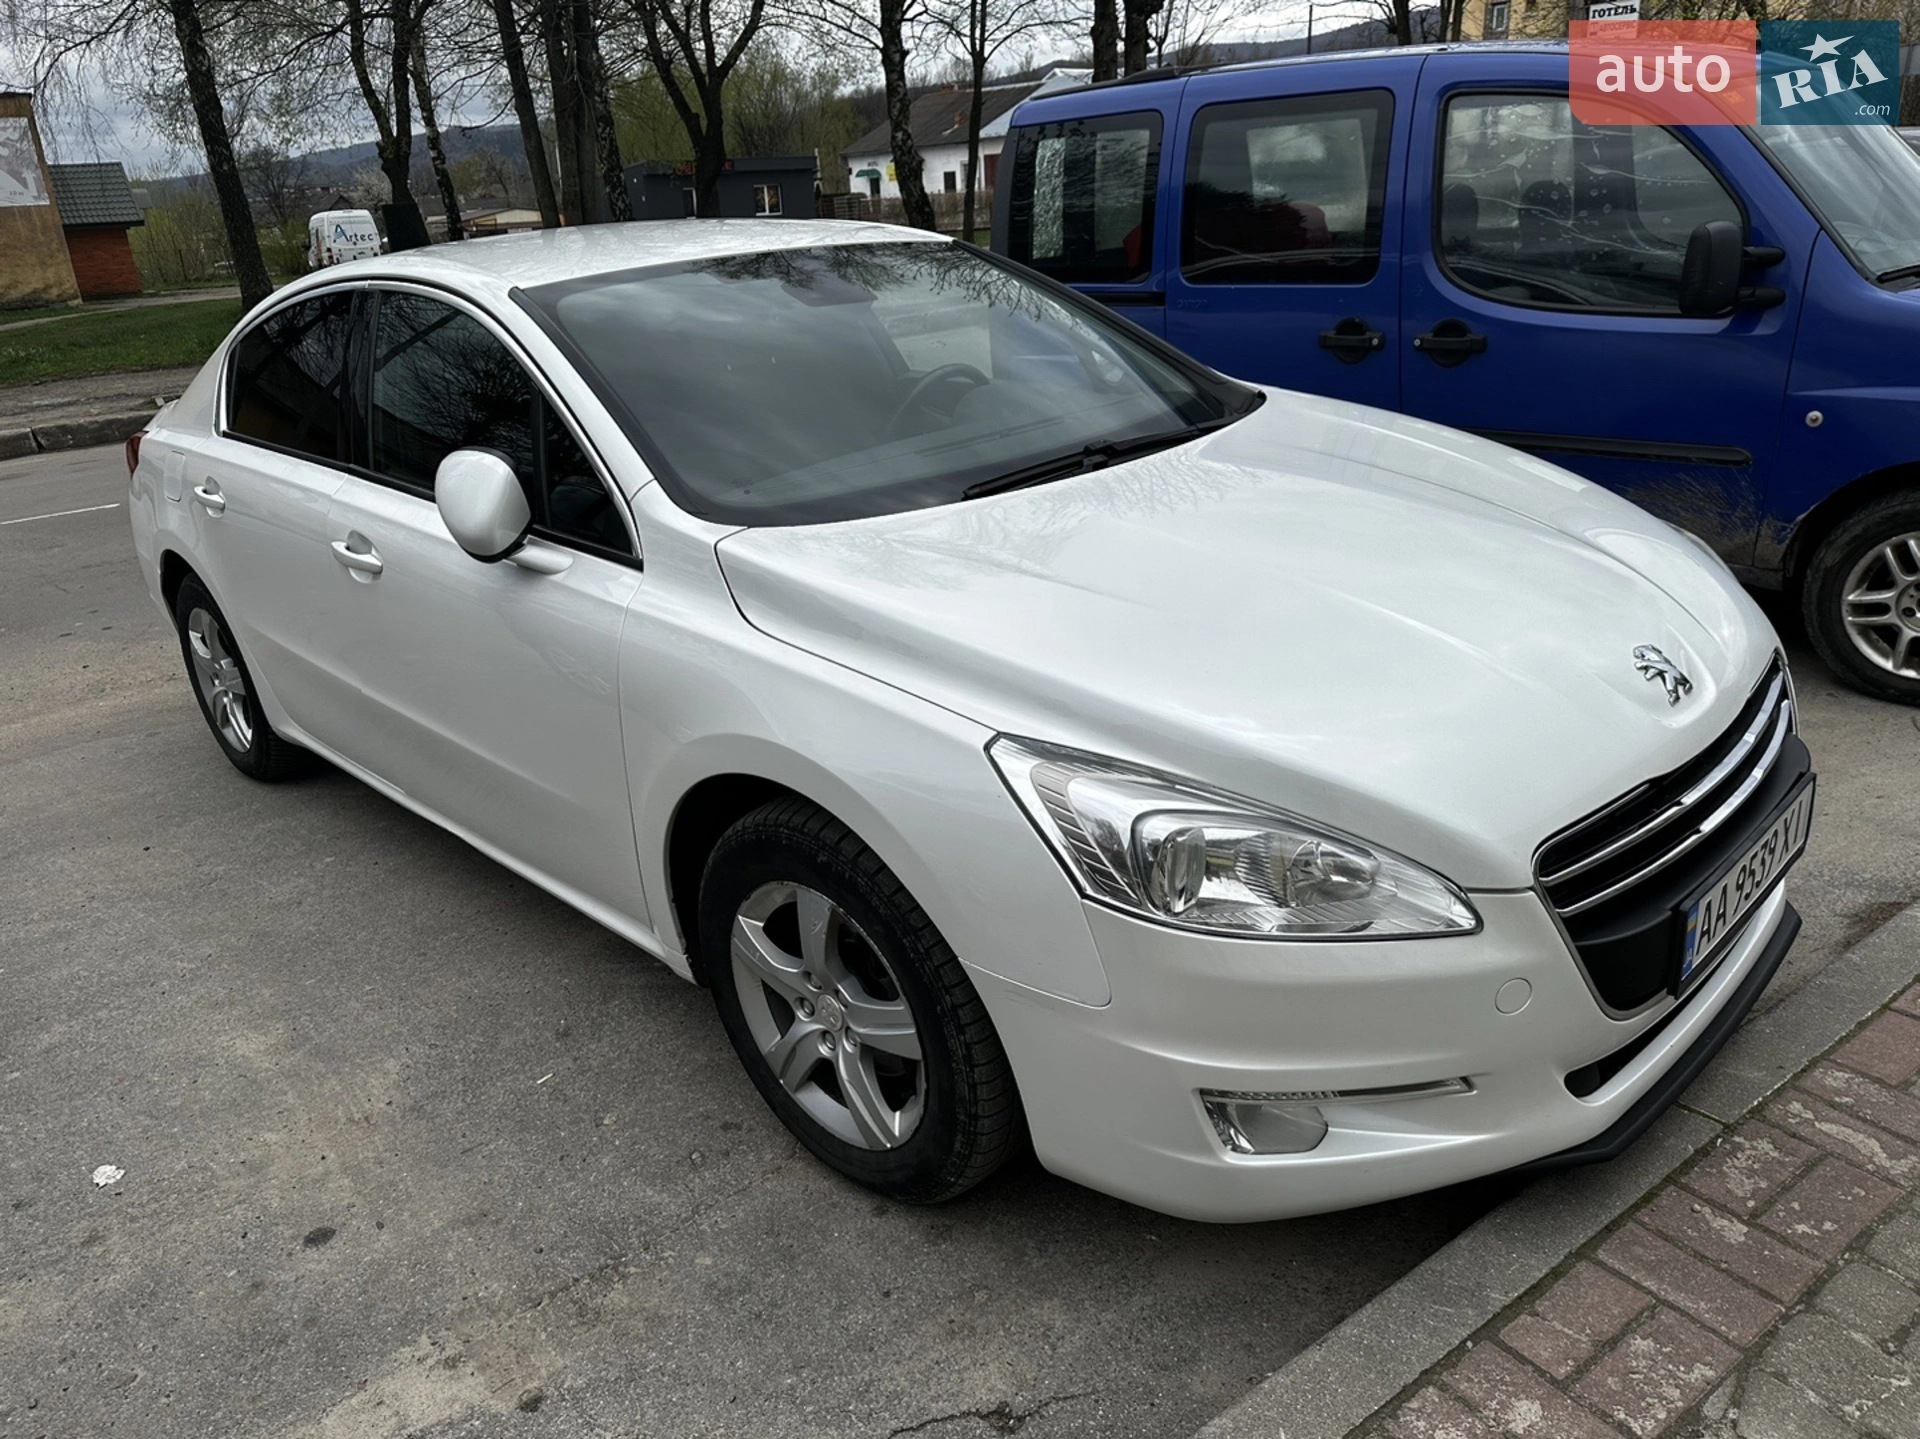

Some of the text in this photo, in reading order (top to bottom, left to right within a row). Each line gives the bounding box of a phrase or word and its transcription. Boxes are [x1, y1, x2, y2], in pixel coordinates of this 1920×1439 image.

[1591, 4, 1637, 19] ГОТЕЛЬ
[333, 224, 374, 243] Artec
[1696, 800, 1803, 956] AA 9539 XI
